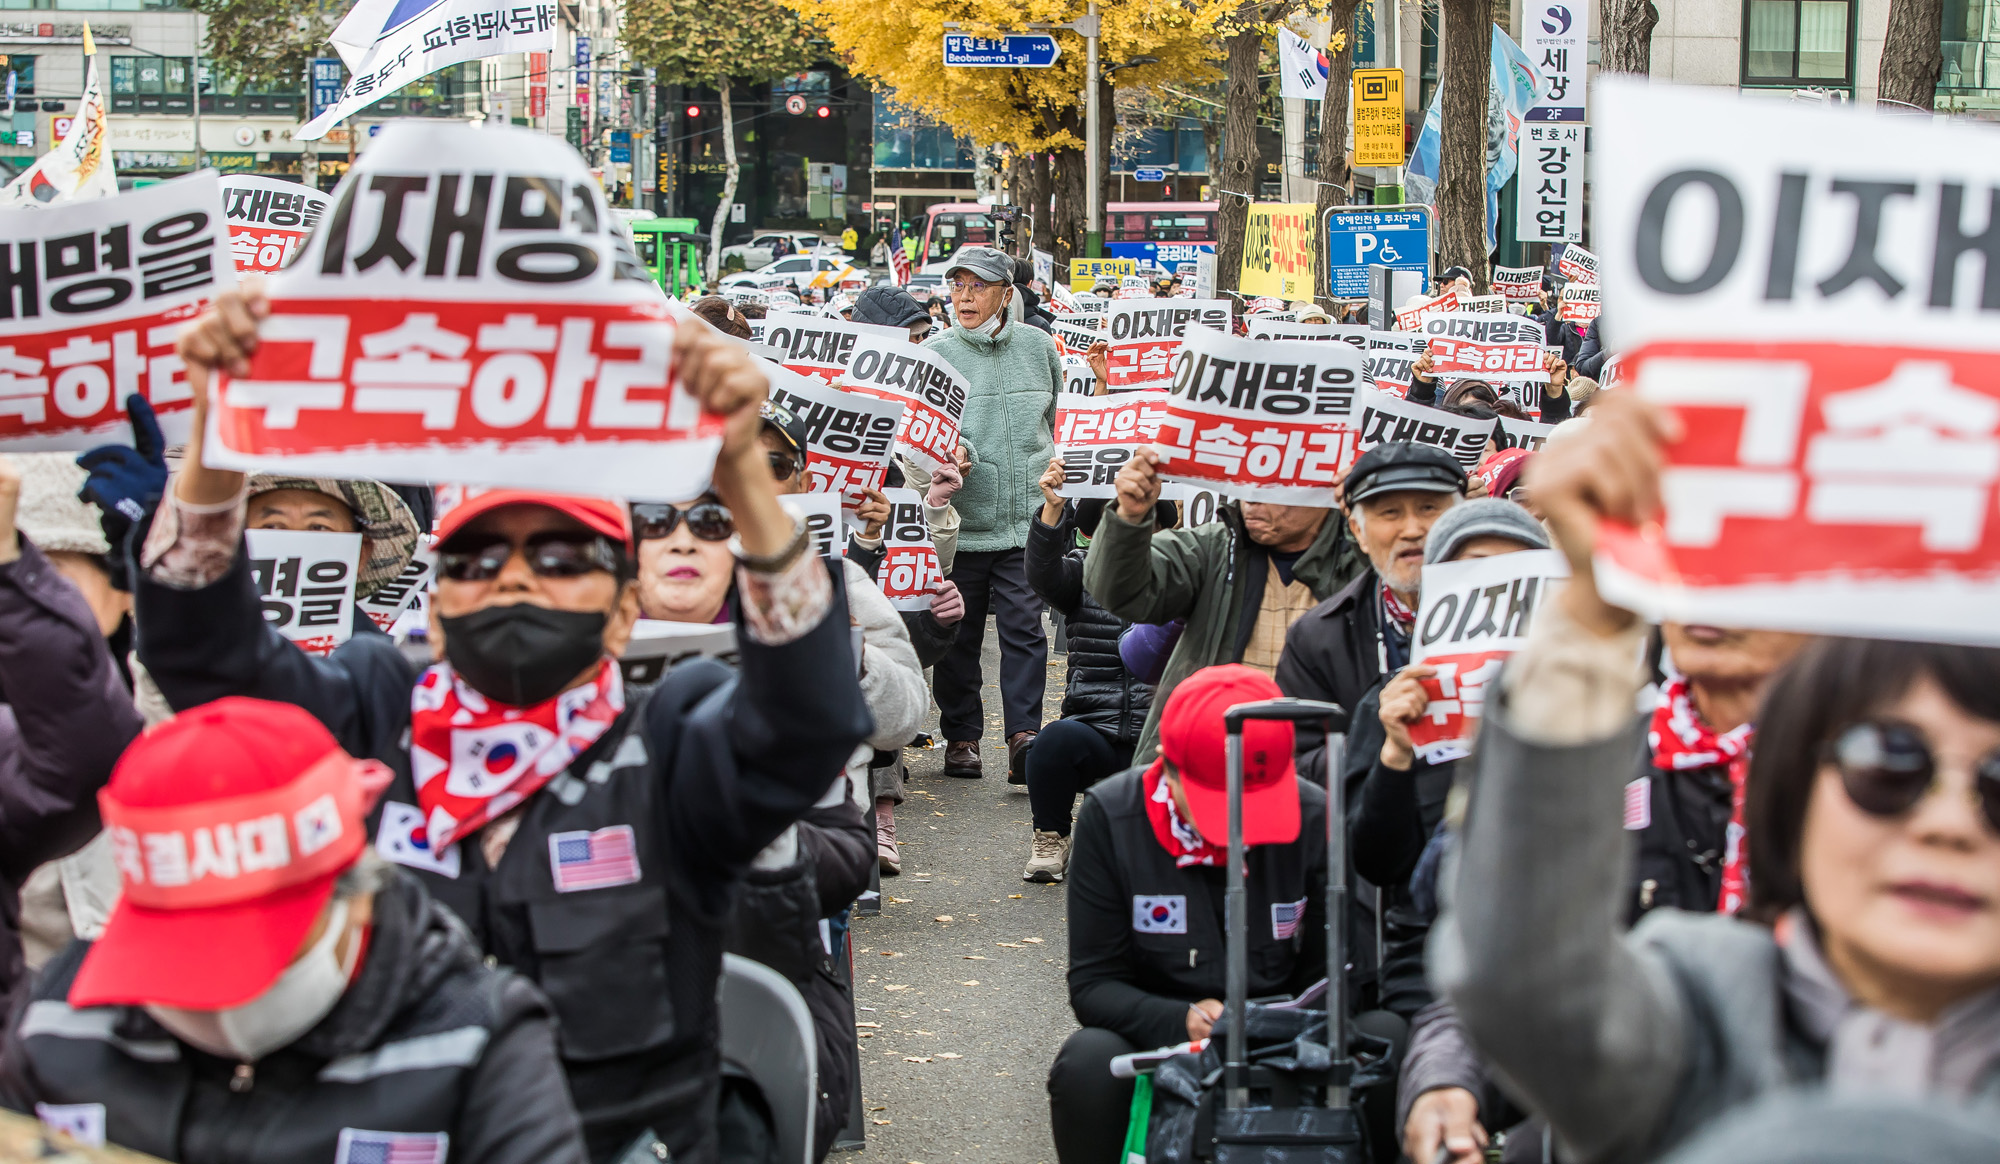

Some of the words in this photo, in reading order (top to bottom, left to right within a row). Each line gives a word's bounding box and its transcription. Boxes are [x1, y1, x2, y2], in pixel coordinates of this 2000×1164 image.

[948, 53, 1006, 63] Beobwon-ro
[1008, 54, 1030, 65] 1-gil
[1541, 49, 1570, 101] 세강
[1356, 107, 1379, 120] 불법주정차
[1382, 106, 1400, 120] 무인단속
[1546, 109, 1562, 120] 2F
[1357, 124, 1370, 137] 다기능
[1531, 128, 1578, 141] 변호사
[1536, 147, 1571, 237] 강신업
[1336, 215, 1381, 225] 장애인전용
[1384, 214, 1420, 223] 주차구역
[229, 231, 305, 269] 속하
[1246, 213, 1271, 273] 이재명
[1355, 233, 1368, 264] P
[1076, 263, 1130, 277] 교통안내
[1496, 271, 1541, 283] 이재명을
[1111, 308, 1227, 341] 이재명을
[1427, 319, 1543, 344] 이재명을
[1432, 340, 1544, 370] 구속하라
[226, 313, 702, 431] 구속하라
[852, 350, 966, 420] 이재명을
[1171, 350, 1355, 416] 이재명을
[1154, 413, 1356, 483] 구속하라
